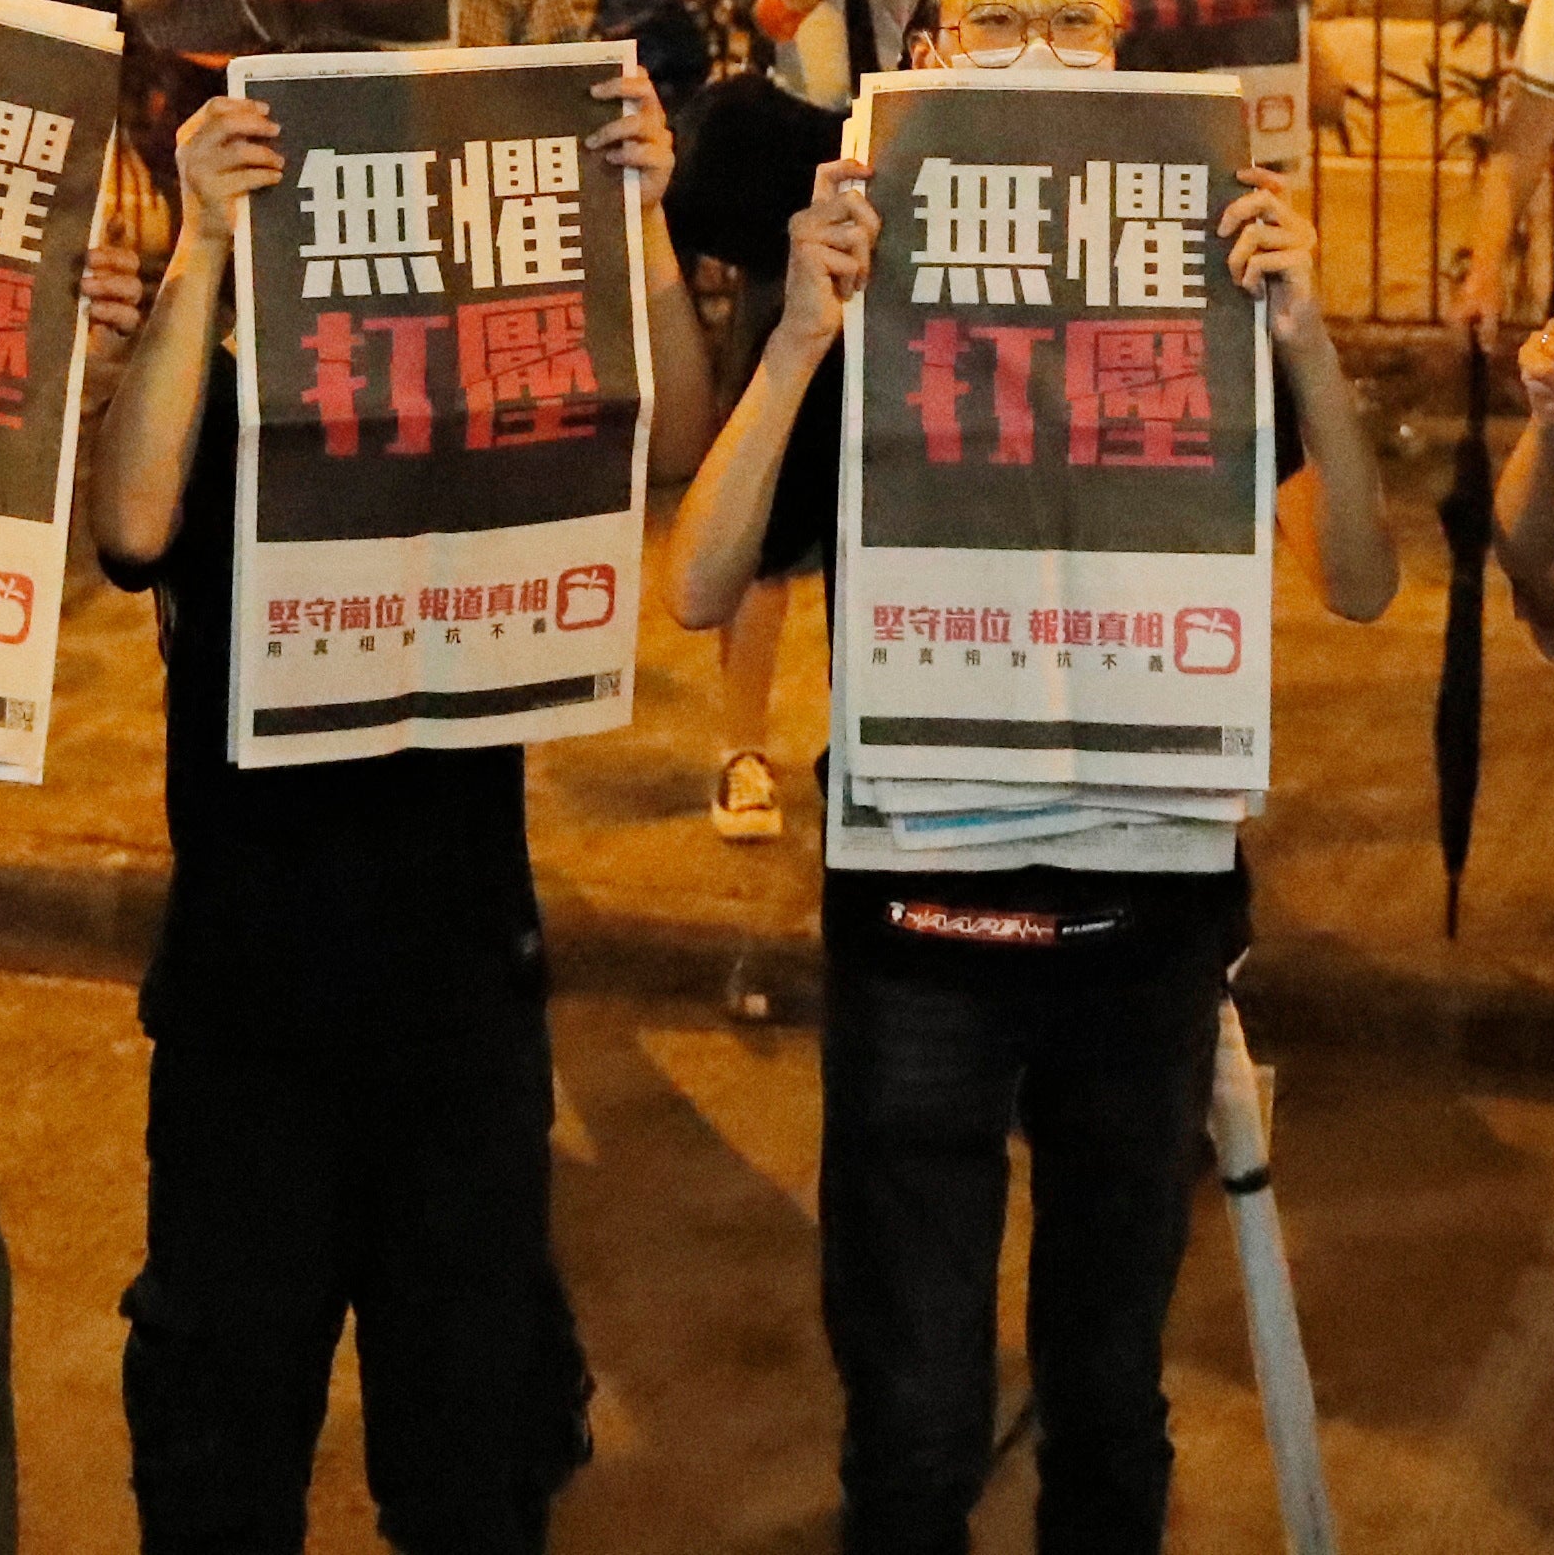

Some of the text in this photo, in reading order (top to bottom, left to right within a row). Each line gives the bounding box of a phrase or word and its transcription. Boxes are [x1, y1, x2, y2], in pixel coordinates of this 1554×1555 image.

[298, 135, 586, 301] 無懼
[911, 157, 1209, 309] 無懼
[300, 290, 599, 458] 打壓
[907, 317, 1215, 468] 打壓
[268, 577, 549, 635] 堅守崗位 報道真相
[871, 648, 1165, 674] 用真相對抗不義
[873, 605, 1165, 648] 堅守崗位 報道真相
